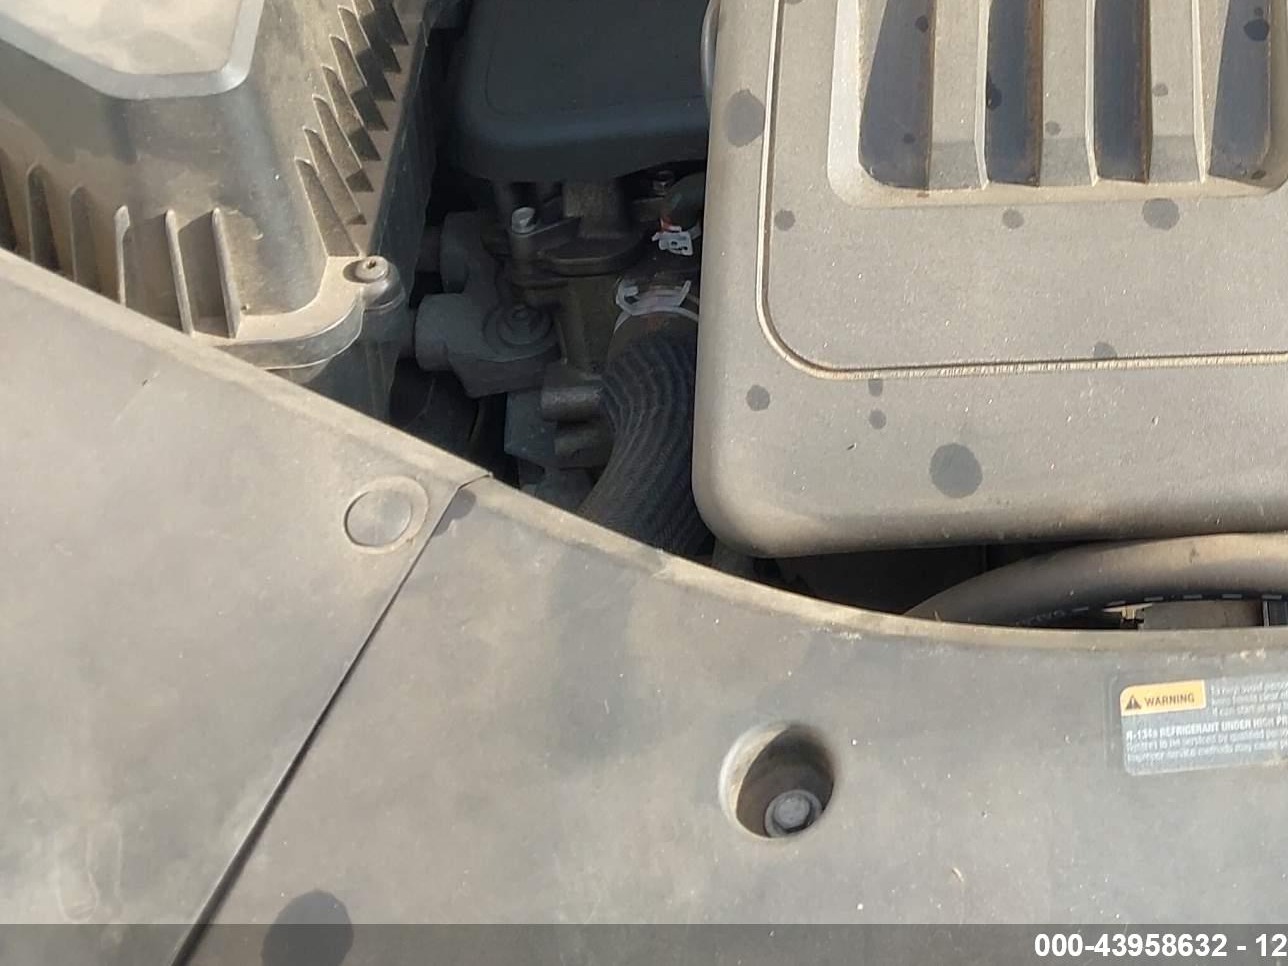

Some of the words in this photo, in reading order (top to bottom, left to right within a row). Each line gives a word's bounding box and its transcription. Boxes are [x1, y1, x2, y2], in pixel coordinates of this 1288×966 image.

[1144, 692, 1196, 708] WARNING
[1160, 722, 1219, 737] REFRIGERANT
[1221, 719, 1251, 731] UNDER
